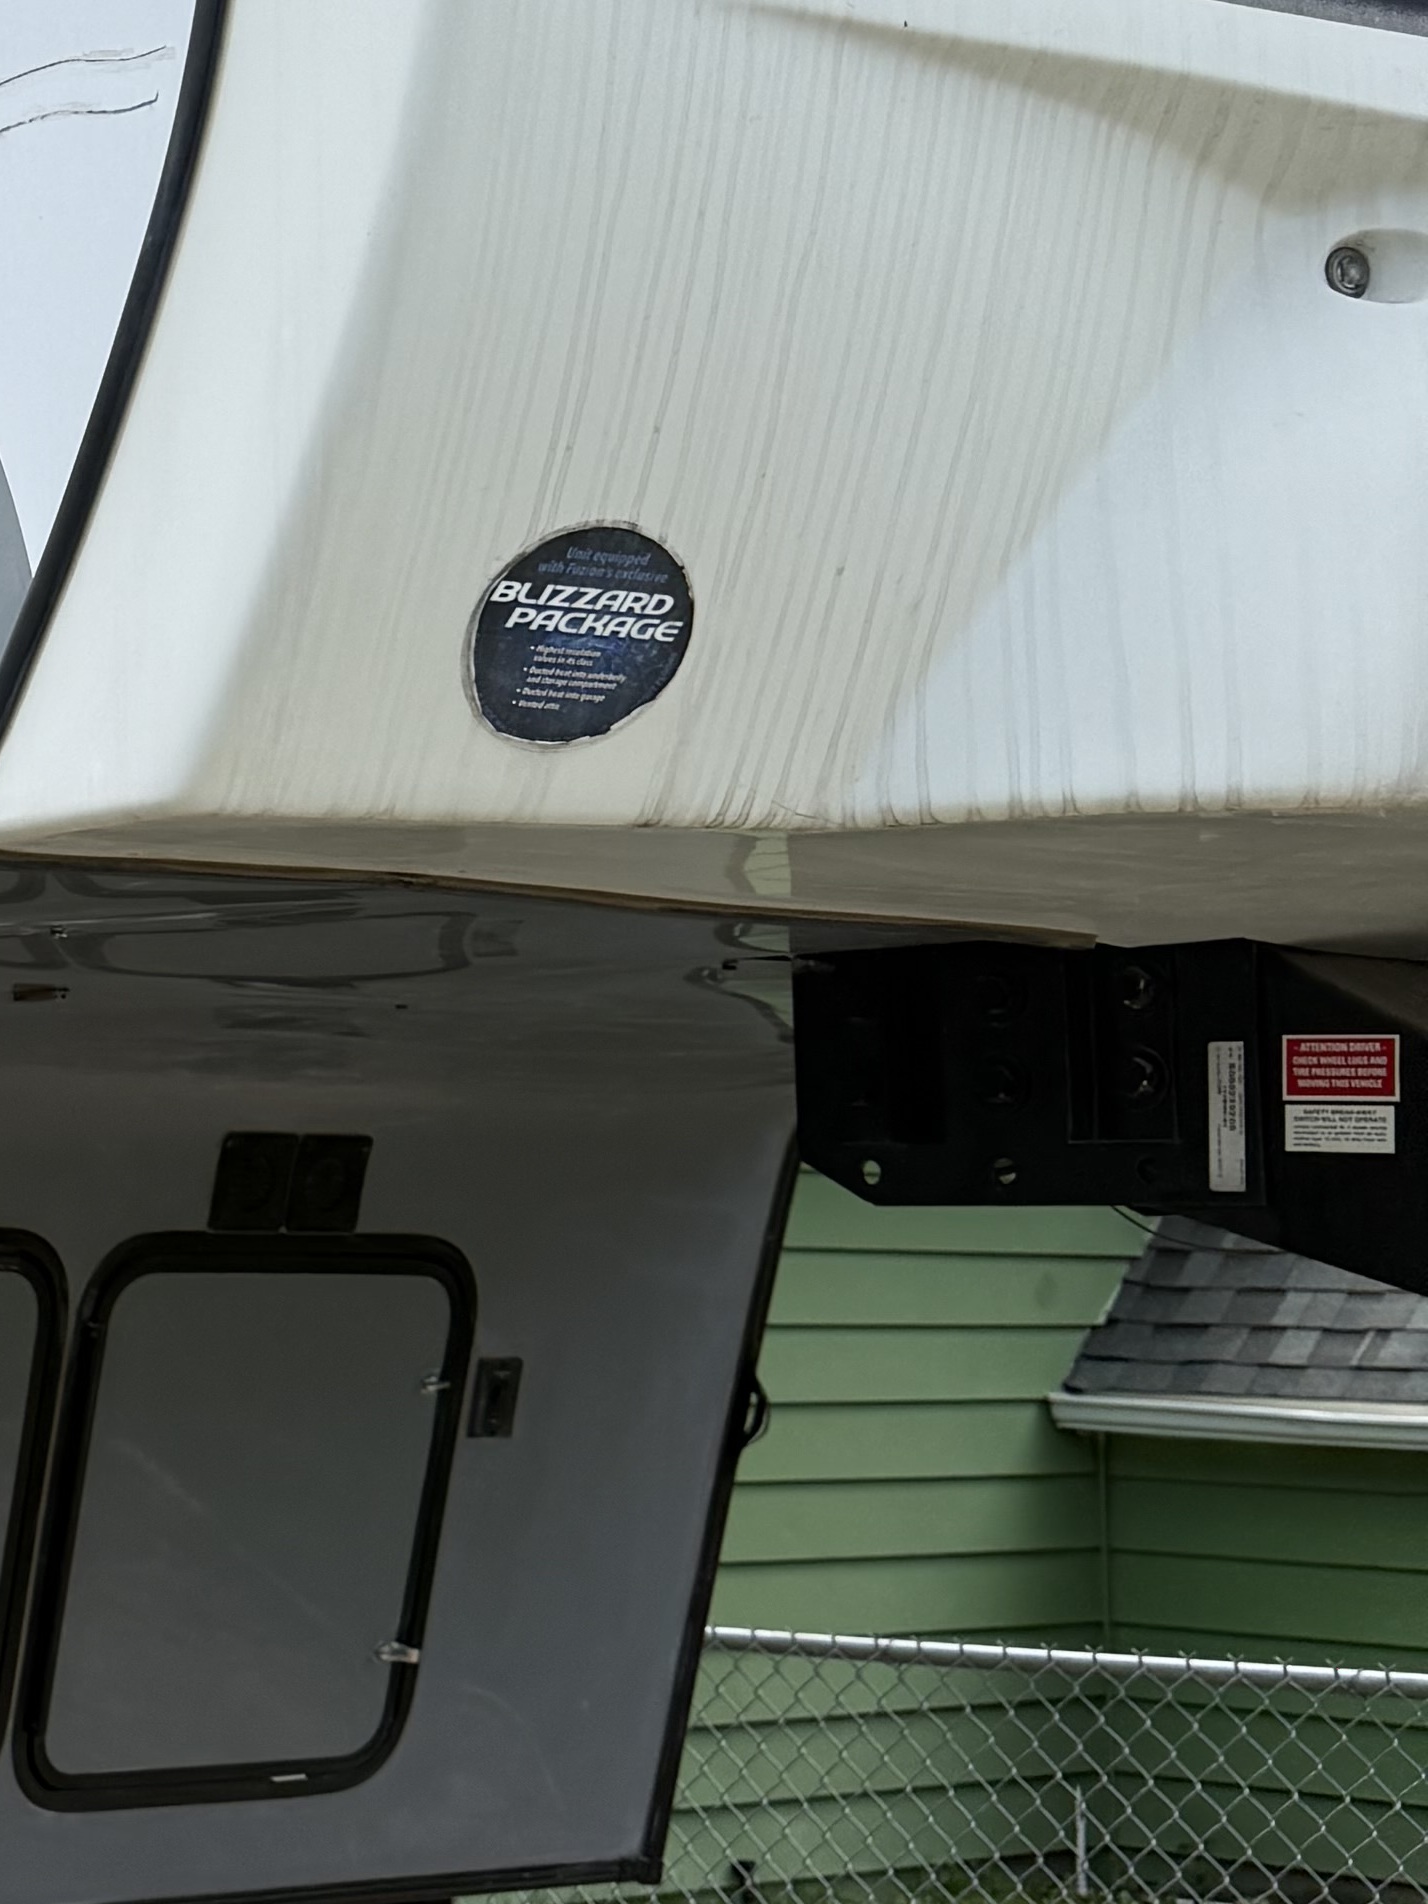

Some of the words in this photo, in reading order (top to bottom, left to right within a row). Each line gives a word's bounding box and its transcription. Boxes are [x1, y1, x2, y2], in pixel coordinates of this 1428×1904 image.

[566, 546, 593, 561] Unit
[593, 550, 652, 567] equipped
[537, 559, 564, 574] with
[614, 568, 669, 583] exclusive
[490, 580, 675, 615] BLIZZARD
[504, 607, 684, 642] PACKAGE
[1300, 1042, 1348, 1052] ATTENTION
[1349, 1042, 1381, 1052] DRIVER
[1292, 1056, 1318, 1065] CHECK
[1319, 1056, 1347, 1065] WHEEL
[1369, 1056, 1388, 1065] AND
[1292, 1067, 1309, 1076] TIRE
[1311, 1067, 1356, 1077] PRESSURES
[1357, 1067, 1388, 1077] BEFORE
[1297, 1078, 1330, 1088] MOVING
[1331, 1078, 1350, 1088] THIS
[1350, 1078, 1383, 1088] VEHICLE
